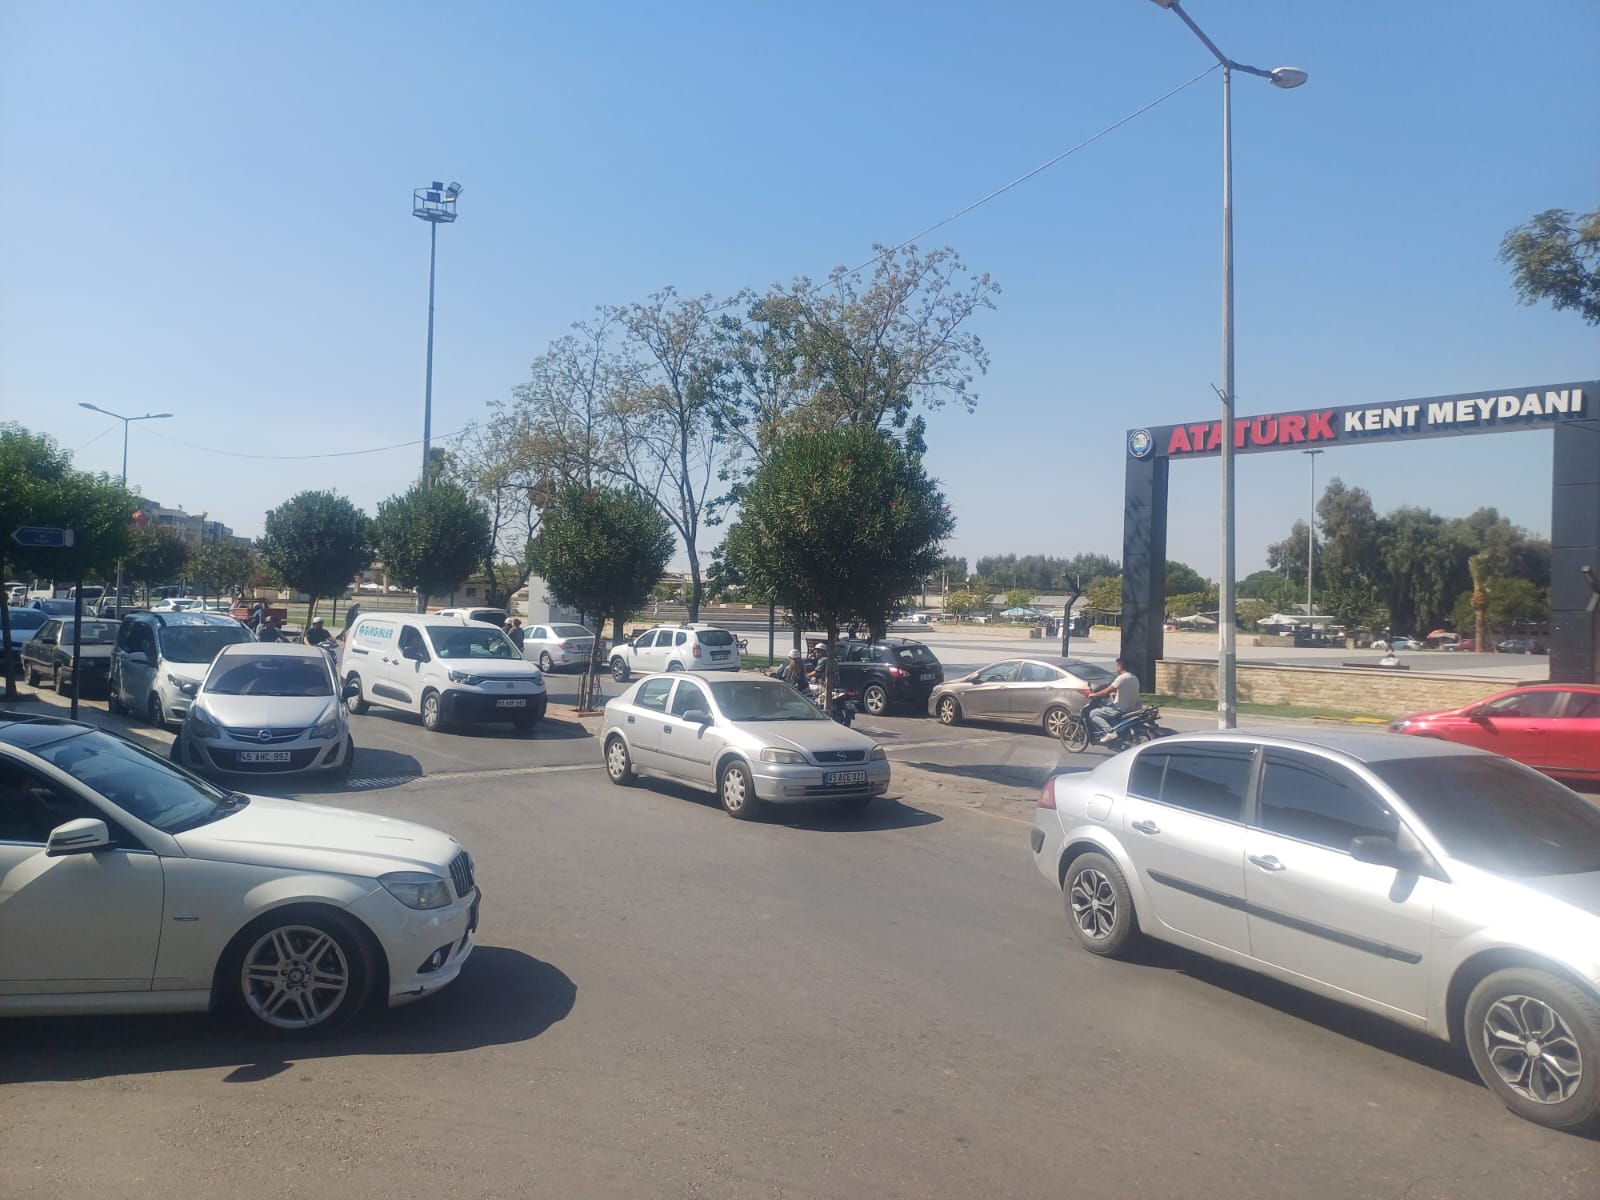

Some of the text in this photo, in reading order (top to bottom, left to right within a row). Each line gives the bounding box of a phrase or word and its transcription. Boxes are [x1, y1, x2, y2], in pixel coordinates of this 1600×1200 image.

[1168, 411, 1335, 454] ATATÜRK
[1344, 405, 1420, 432] KENT
[1427, 389, 1583, 425] MEYDANI
[240, 752, 289, 761] 45 AHC 992
[828, 773, 838, 782] 45
[838, 772, 851, 781] ACE
